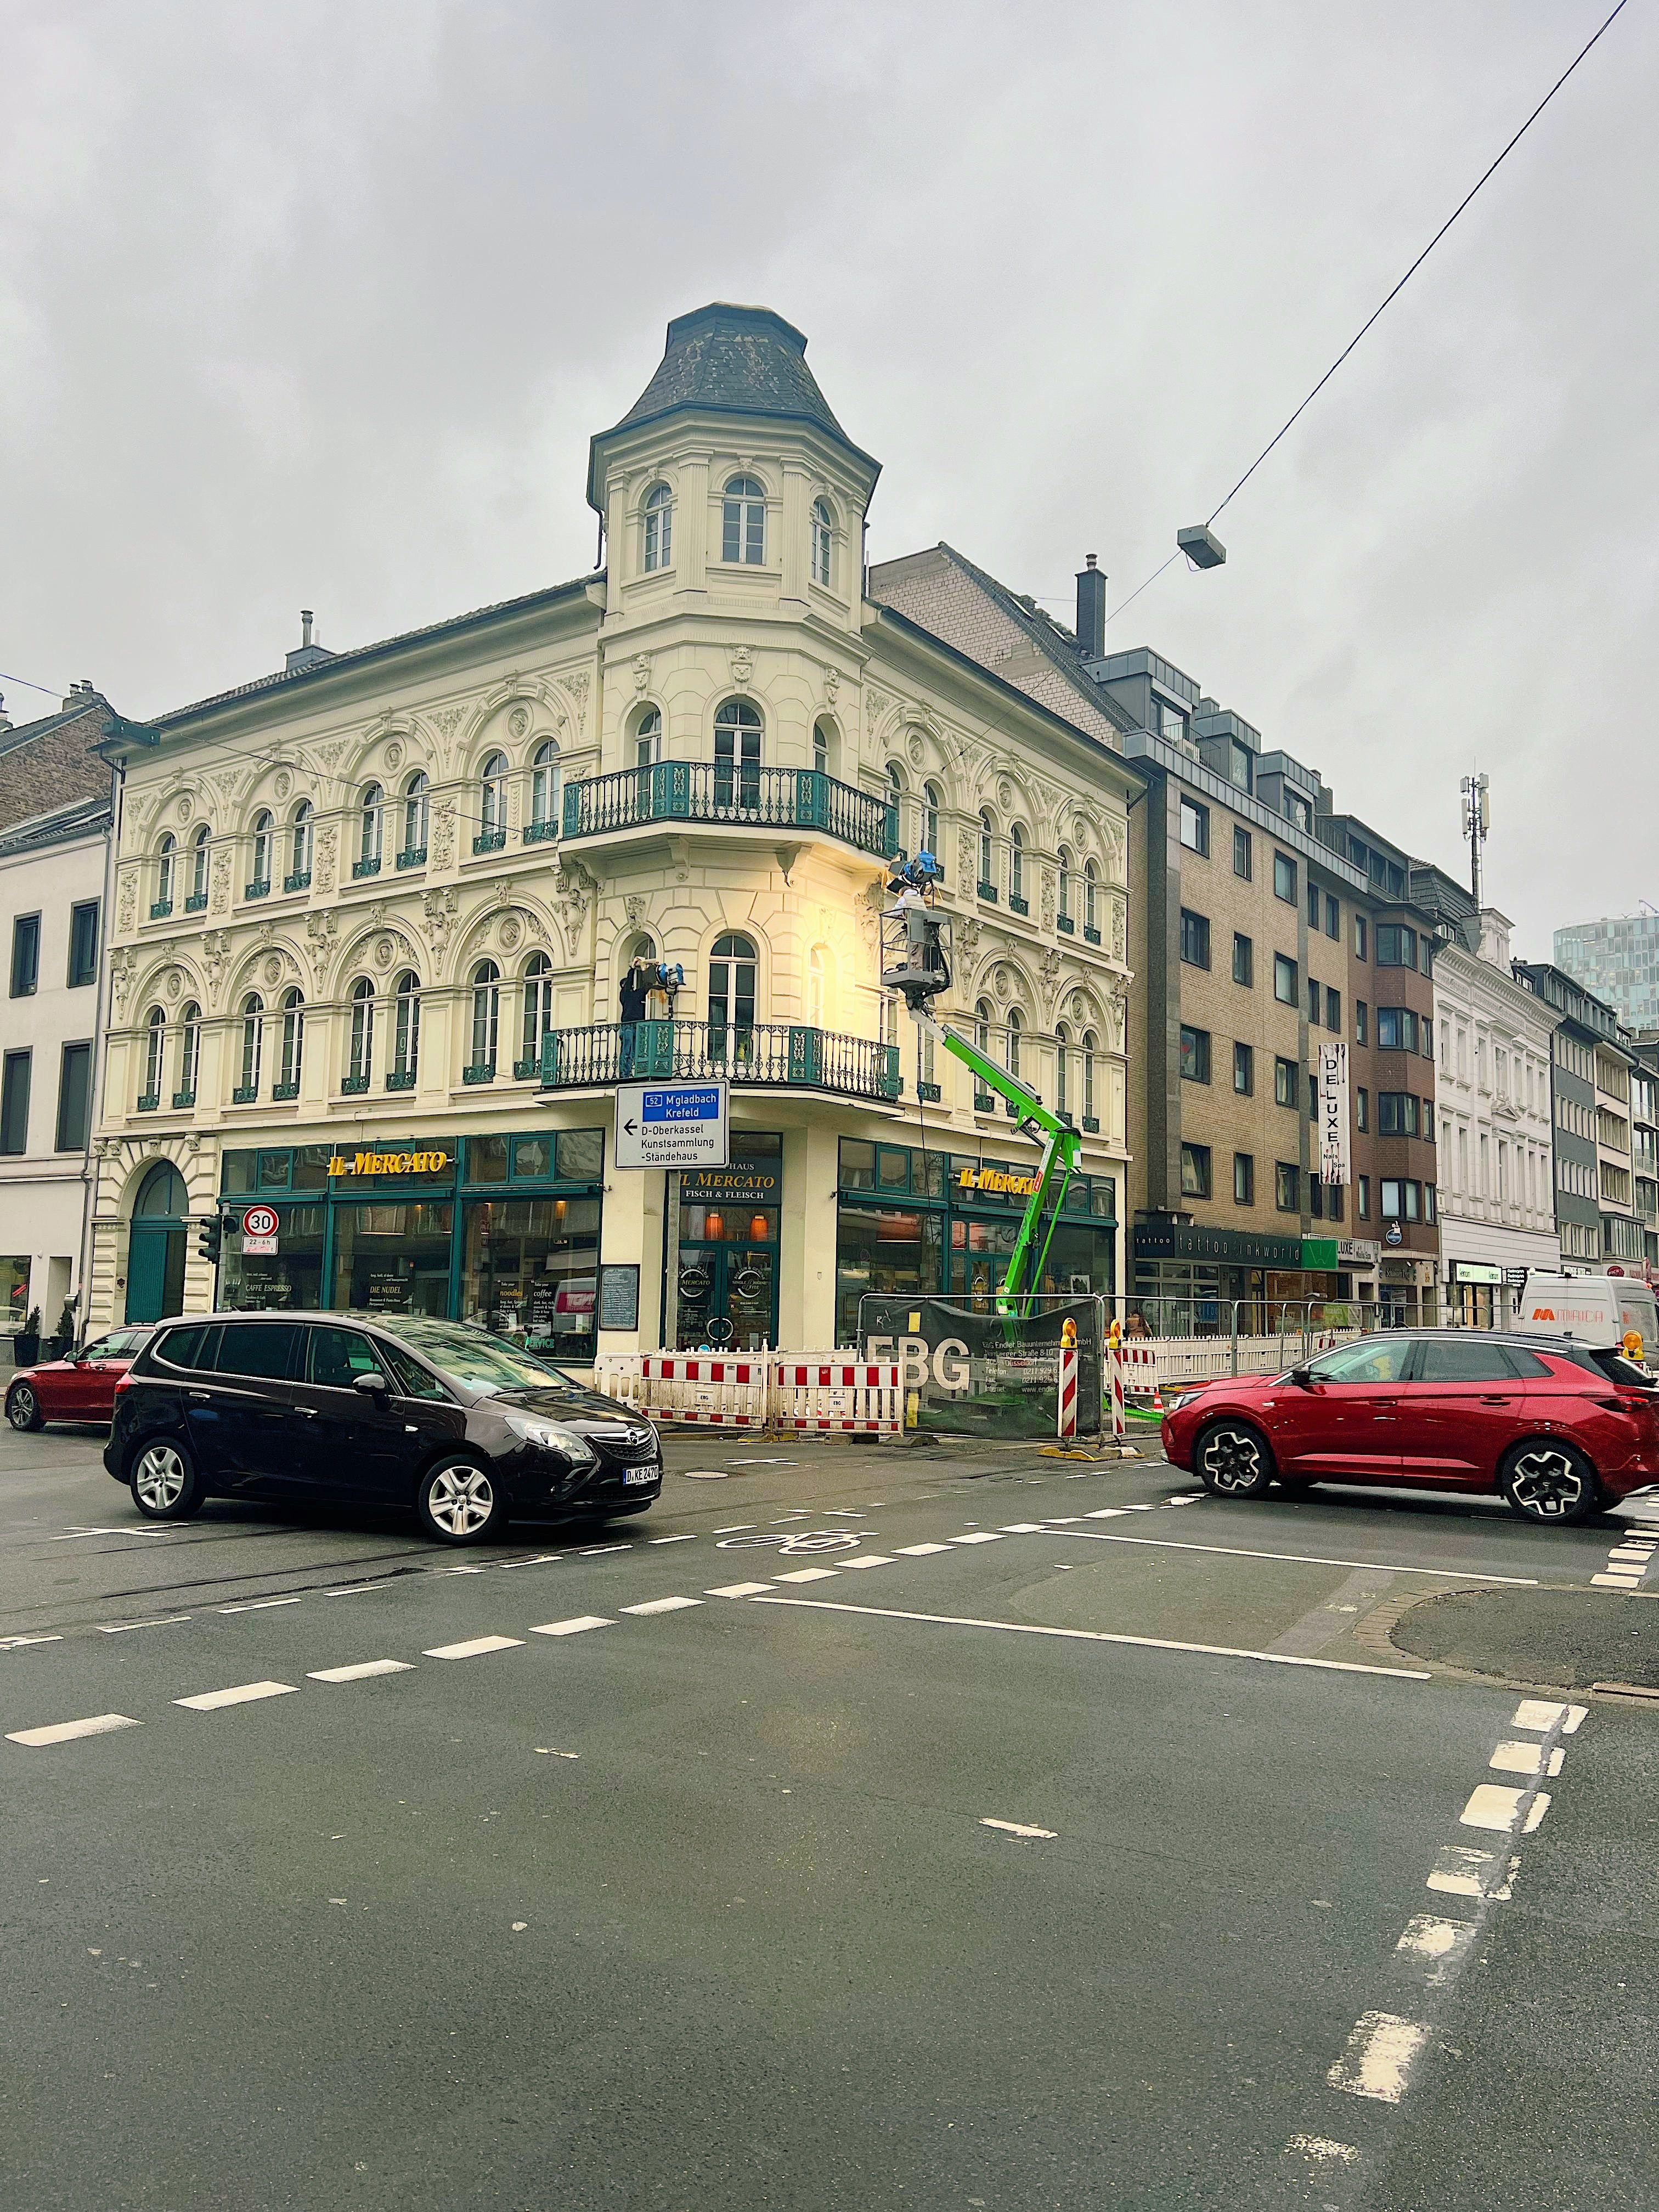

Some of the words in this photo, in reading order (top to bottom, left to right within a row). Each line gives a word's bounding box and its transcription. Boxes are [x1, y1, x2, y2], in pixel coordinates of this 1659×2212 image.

[1326, 1060, 1338, 1142] DELUXE
[666, 1108, 699, 1118] Krefeld
[642, 1124, 703, 1135] D-Oberkassel
[641, 1138, 714, 1148] Kunstsammlung
[351, 1152, 447, 1175] MERCATO
[695, 1173, 774, 1188] MERCATO
[977, 1168, 1036, 1195] MERCAT
[725, 1191, 764, 1199] FLEISCH
[251, 1215, 270, 1229] 30
[1180, 1234, 1228, 1254] tattoo
[533, 1289, 552, 1298] coffee
[1018, 1349, 1038, 1357] Straße
[867, 1335, 970, 1390] EBG
